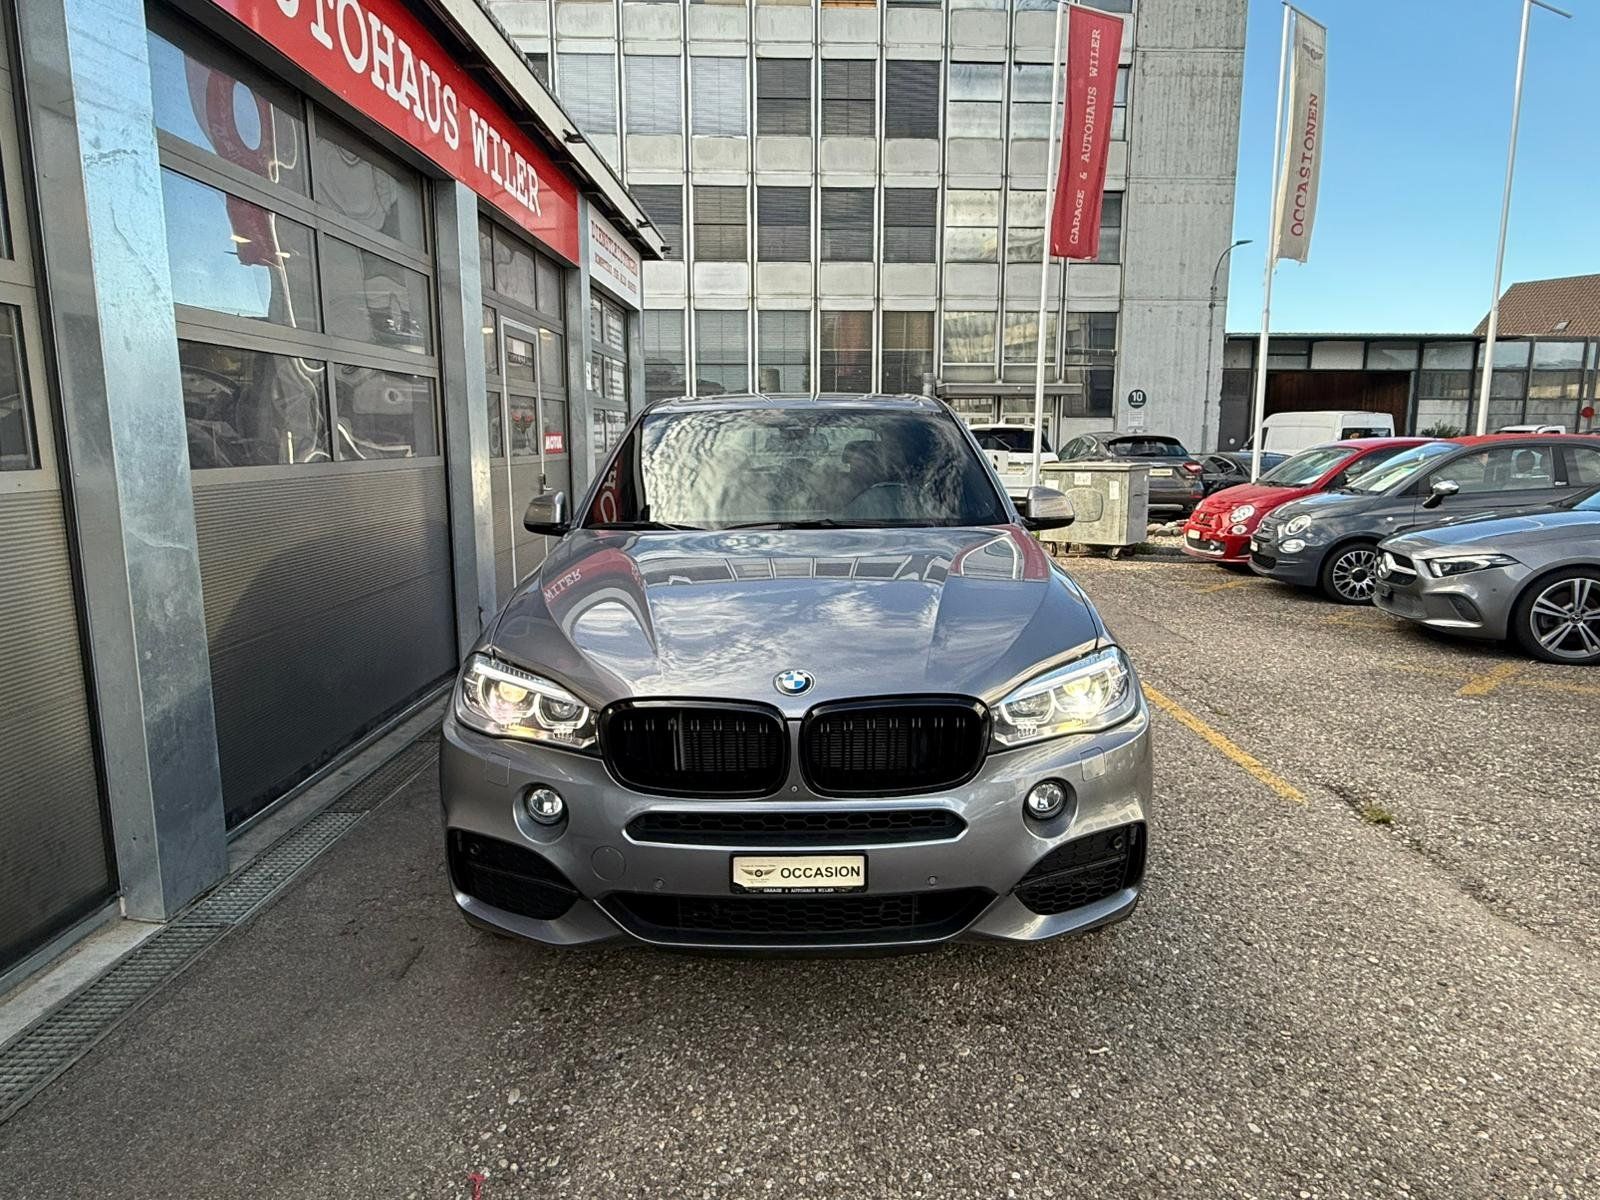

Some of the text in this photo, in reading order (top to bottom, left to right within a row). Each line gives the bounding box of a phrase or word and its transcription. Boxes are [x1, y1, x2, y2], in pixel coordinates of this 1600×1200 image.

[275, 0, 542, 217] TOHAUS WILER
[1069, 189, 1085, 244] GARAGE
[1081, 86, 1097, 163] AUTOHAUS
[1089, 28, 1101, 77] WILER
[1291, 93, 1318, 237] OCCASIONEN
[1131, 391, 1143, 402] 10
[780, 865, 861, 879] OCCASION
